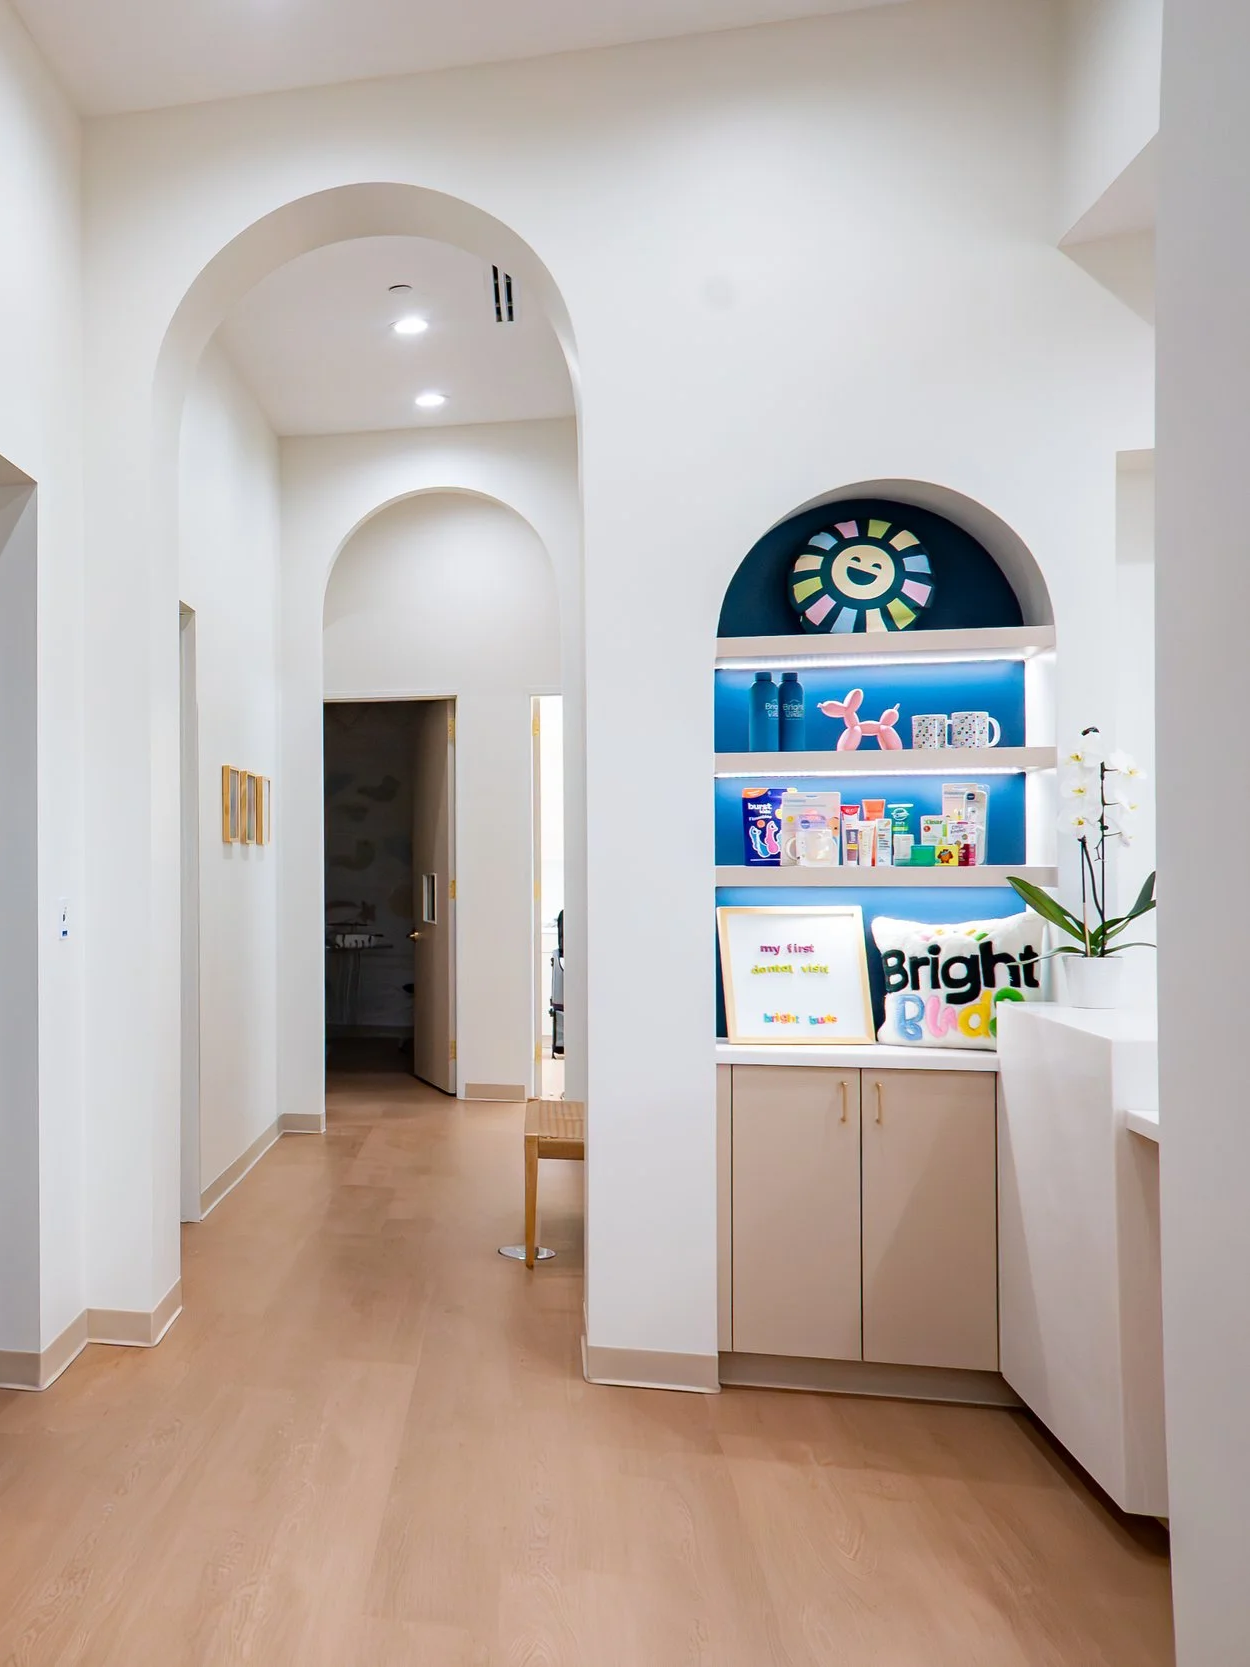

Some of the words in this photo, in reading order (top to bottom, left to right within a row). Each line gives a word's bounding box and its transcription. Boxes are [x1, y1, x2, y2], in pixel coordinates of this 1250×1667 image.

[760, 944, 781, 956] my
[787, 943, 815, 954] first
[751, 964, 794, 975] dental
[800, 964, 829, 975] visit
[881, 940, 1040, 1005] Bright
[763, 1012, 800, 1024] bright
[808, 1014, 838, 1025] buds
